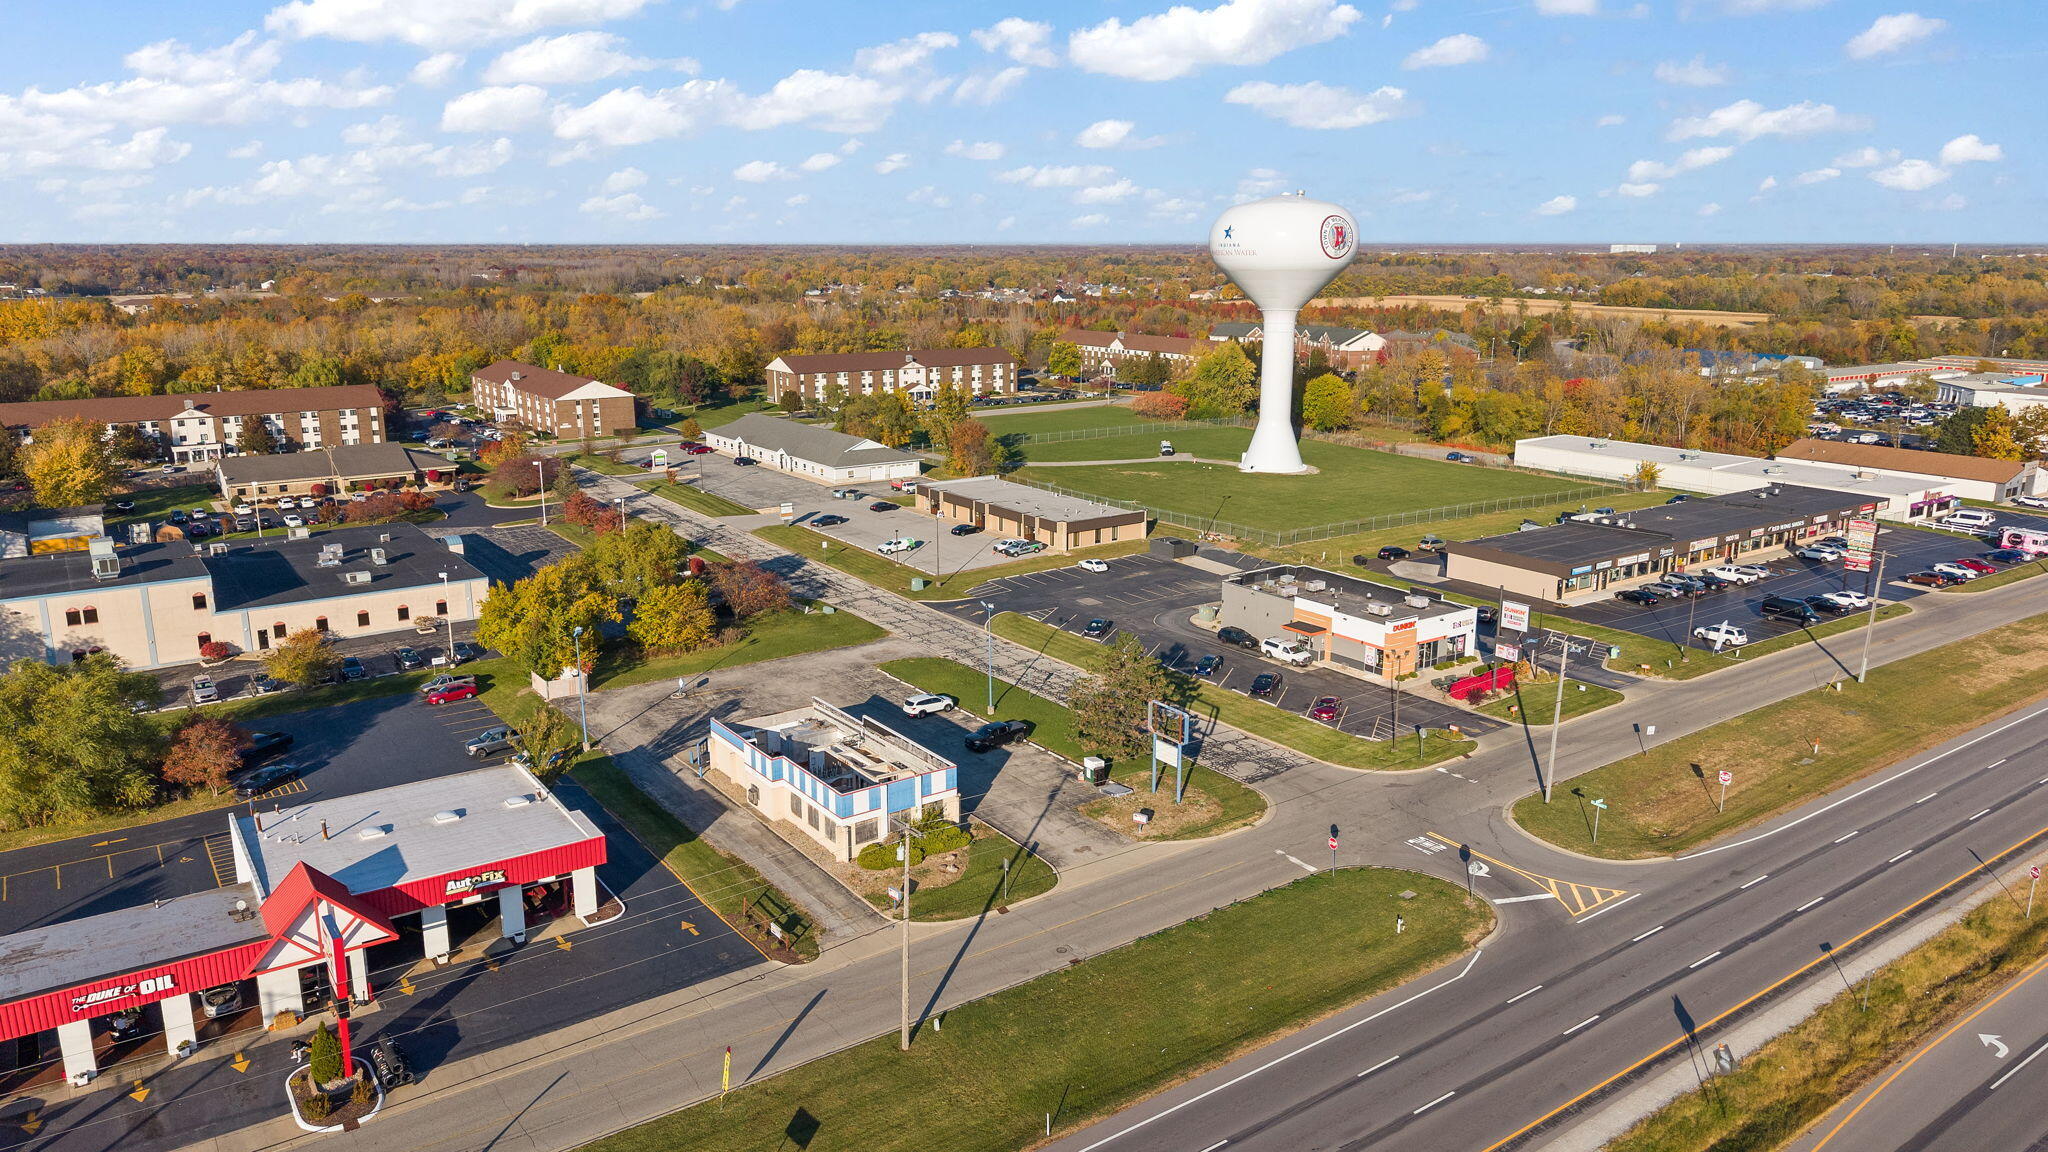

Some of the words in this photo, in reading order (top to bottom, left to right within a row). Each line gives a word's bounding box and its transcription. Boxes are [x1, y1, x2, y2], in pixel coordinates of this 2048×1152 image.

[446, 869, 506, 892] AutoFix
[71, 995, 87, 1005] THE
[86, 986, 122, 1003] DUKE
[123, 984, 137, 994] OF
[139, 974, 175, 995] OIL
